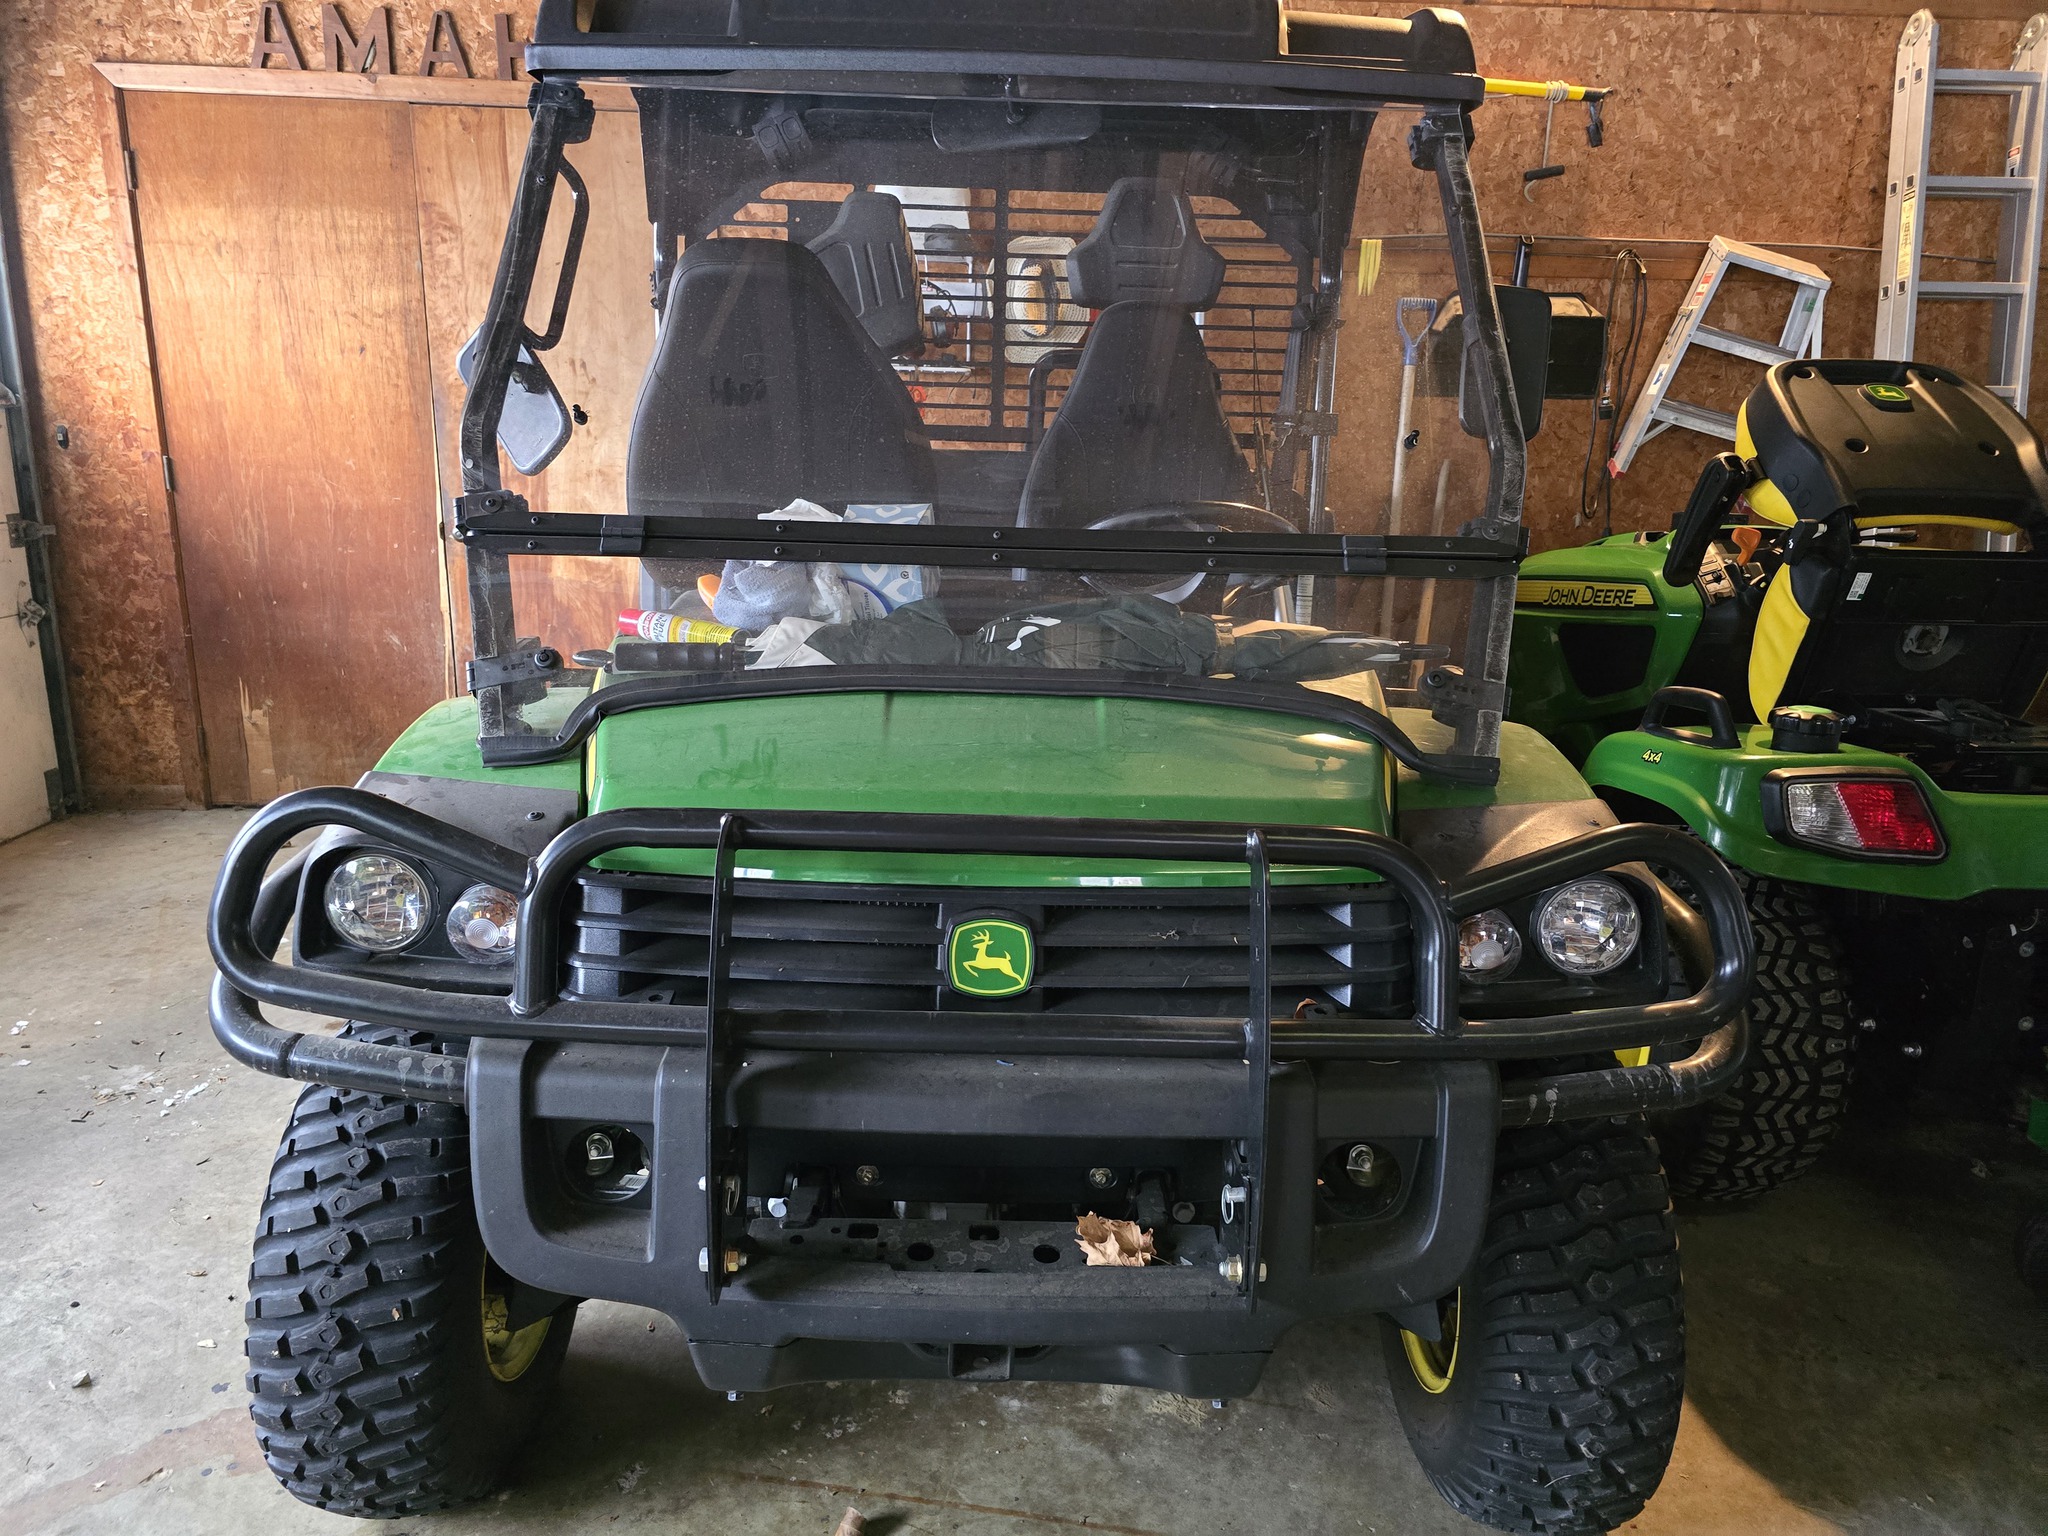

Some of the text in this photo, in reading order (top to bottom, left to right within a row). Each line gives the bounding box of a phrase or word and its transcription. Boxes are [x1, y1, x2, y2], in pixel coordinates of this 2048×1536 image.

[1543, 585, 1636, 607] JOHN DEERE
[1641, 749, 1663, 764] 4x4
